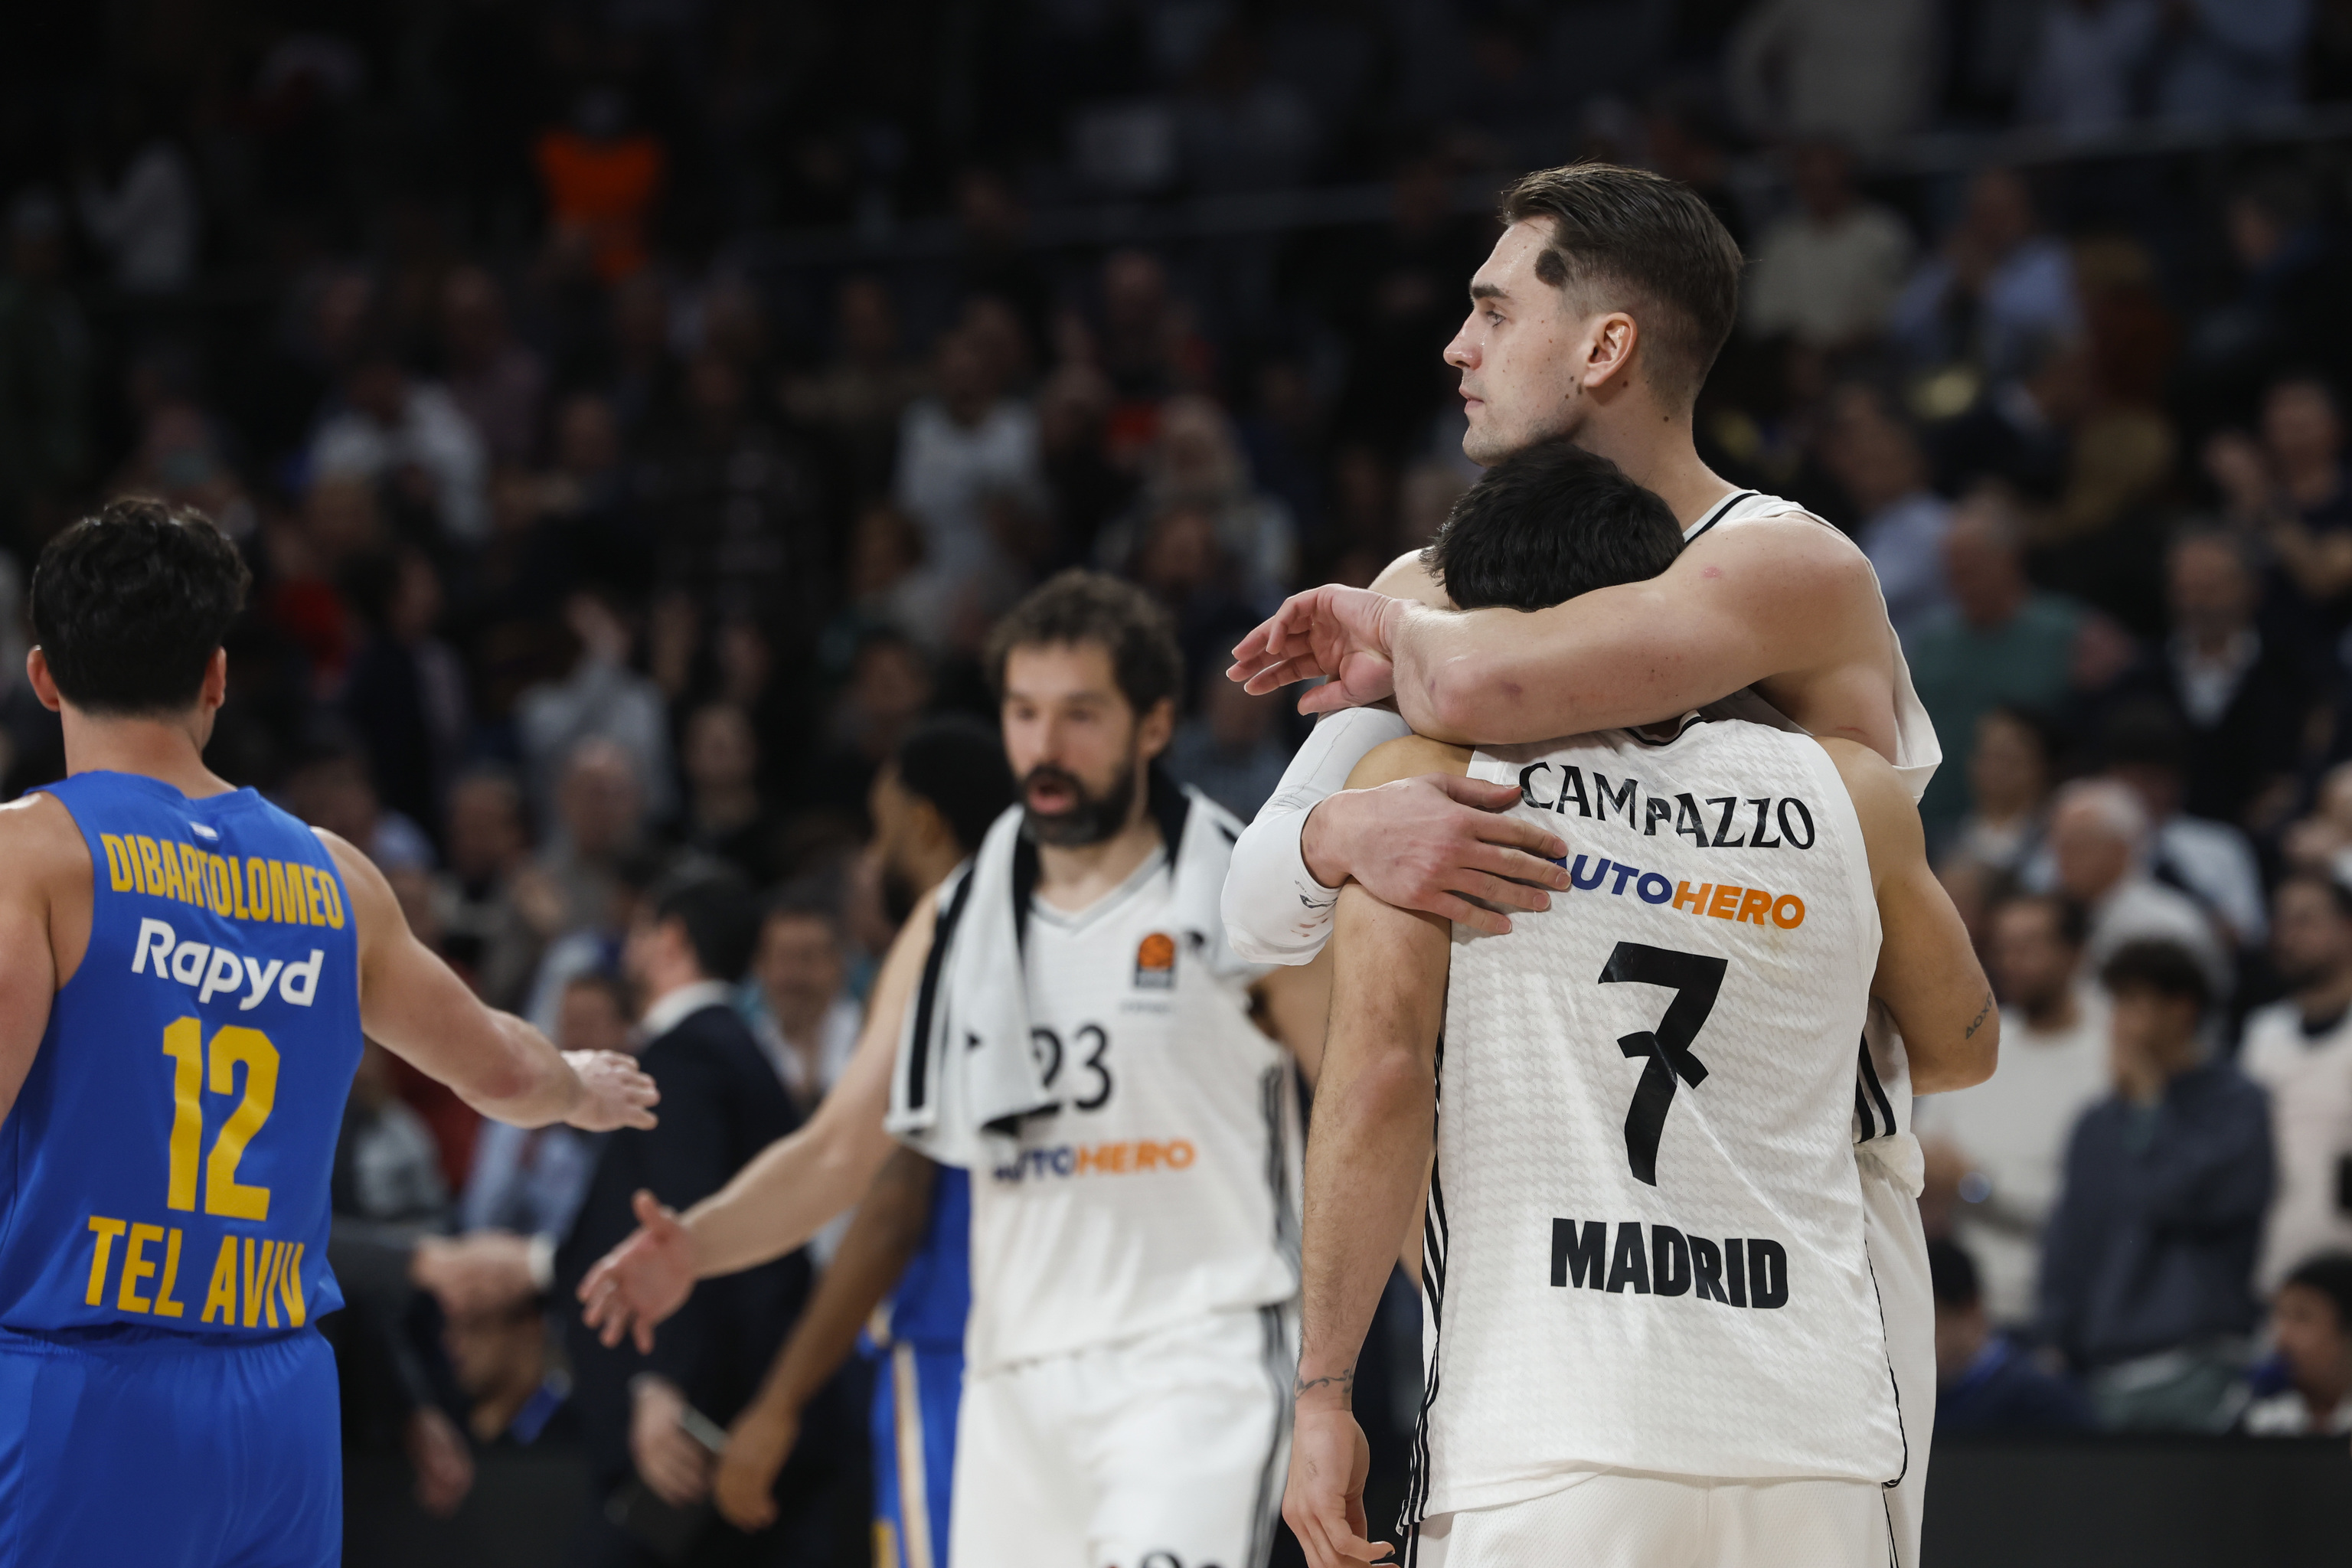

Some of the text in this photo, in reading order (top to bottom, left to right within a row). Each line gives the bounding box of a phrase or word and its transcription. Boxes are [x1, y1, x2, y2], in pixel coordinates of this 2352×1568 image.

[1519, 761, 1815, 849] CAMPAZZO
[100, 833, 345, 929] DIBARTOLOMEO
[131, 917, 325, 1011] Rapyd
[1598, 941, 1729, 1187] 7
[162, 1015, 280, 1221] 12
[85, 1215, 306, 1328] TEL AVIV
[1550, 1217, 1788, 1309] MADRID
